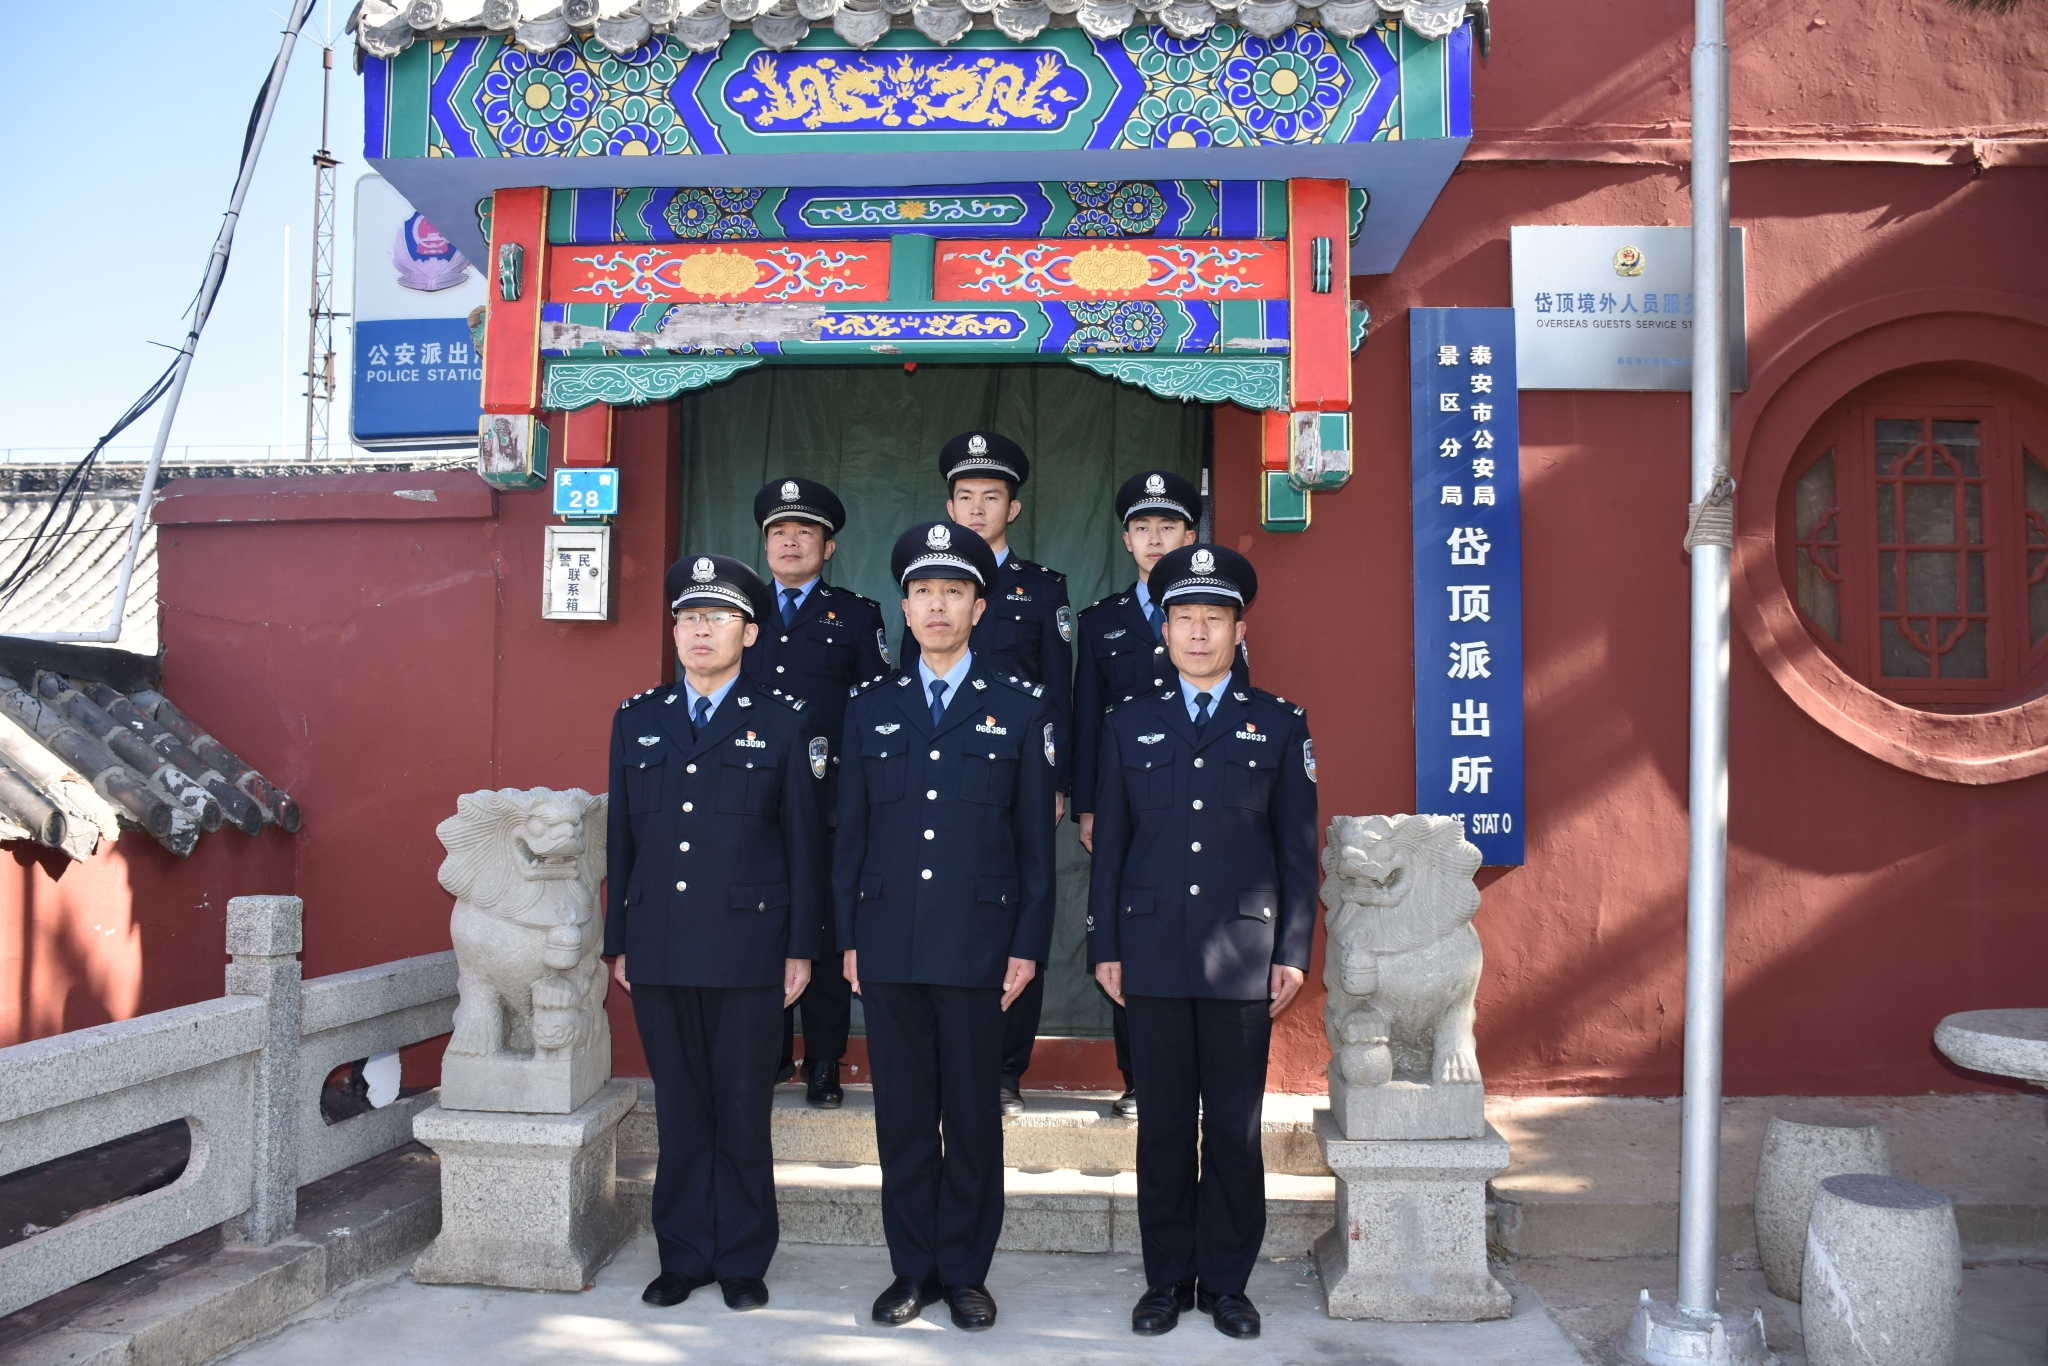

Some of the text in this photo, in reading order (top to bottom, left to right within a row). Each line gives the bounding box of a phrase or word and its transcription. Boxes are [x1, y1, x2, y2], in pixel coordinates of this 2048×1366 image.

[1536, 319, 1588, 328] OVERSEAS
[1592, 319, 1632, 329] GUESTS
[1636, 320, 1677, 329] SERVICE
[367, 342, 480, 366] 公安派出
[366, 368, 420, 382] POLICE
[1437, 345, 1463, 506] 景区分局
[1470, 345, 1496, 507] 泰安市公安局
[569, 490, 599, 508] 28
[1446, 527, 1493, 794] 岱顶派出所
[975, 724, 1007, 736] 066386
[1235, 730, 1267, 742] 063033
[735, 738, 766, 749] 063090
